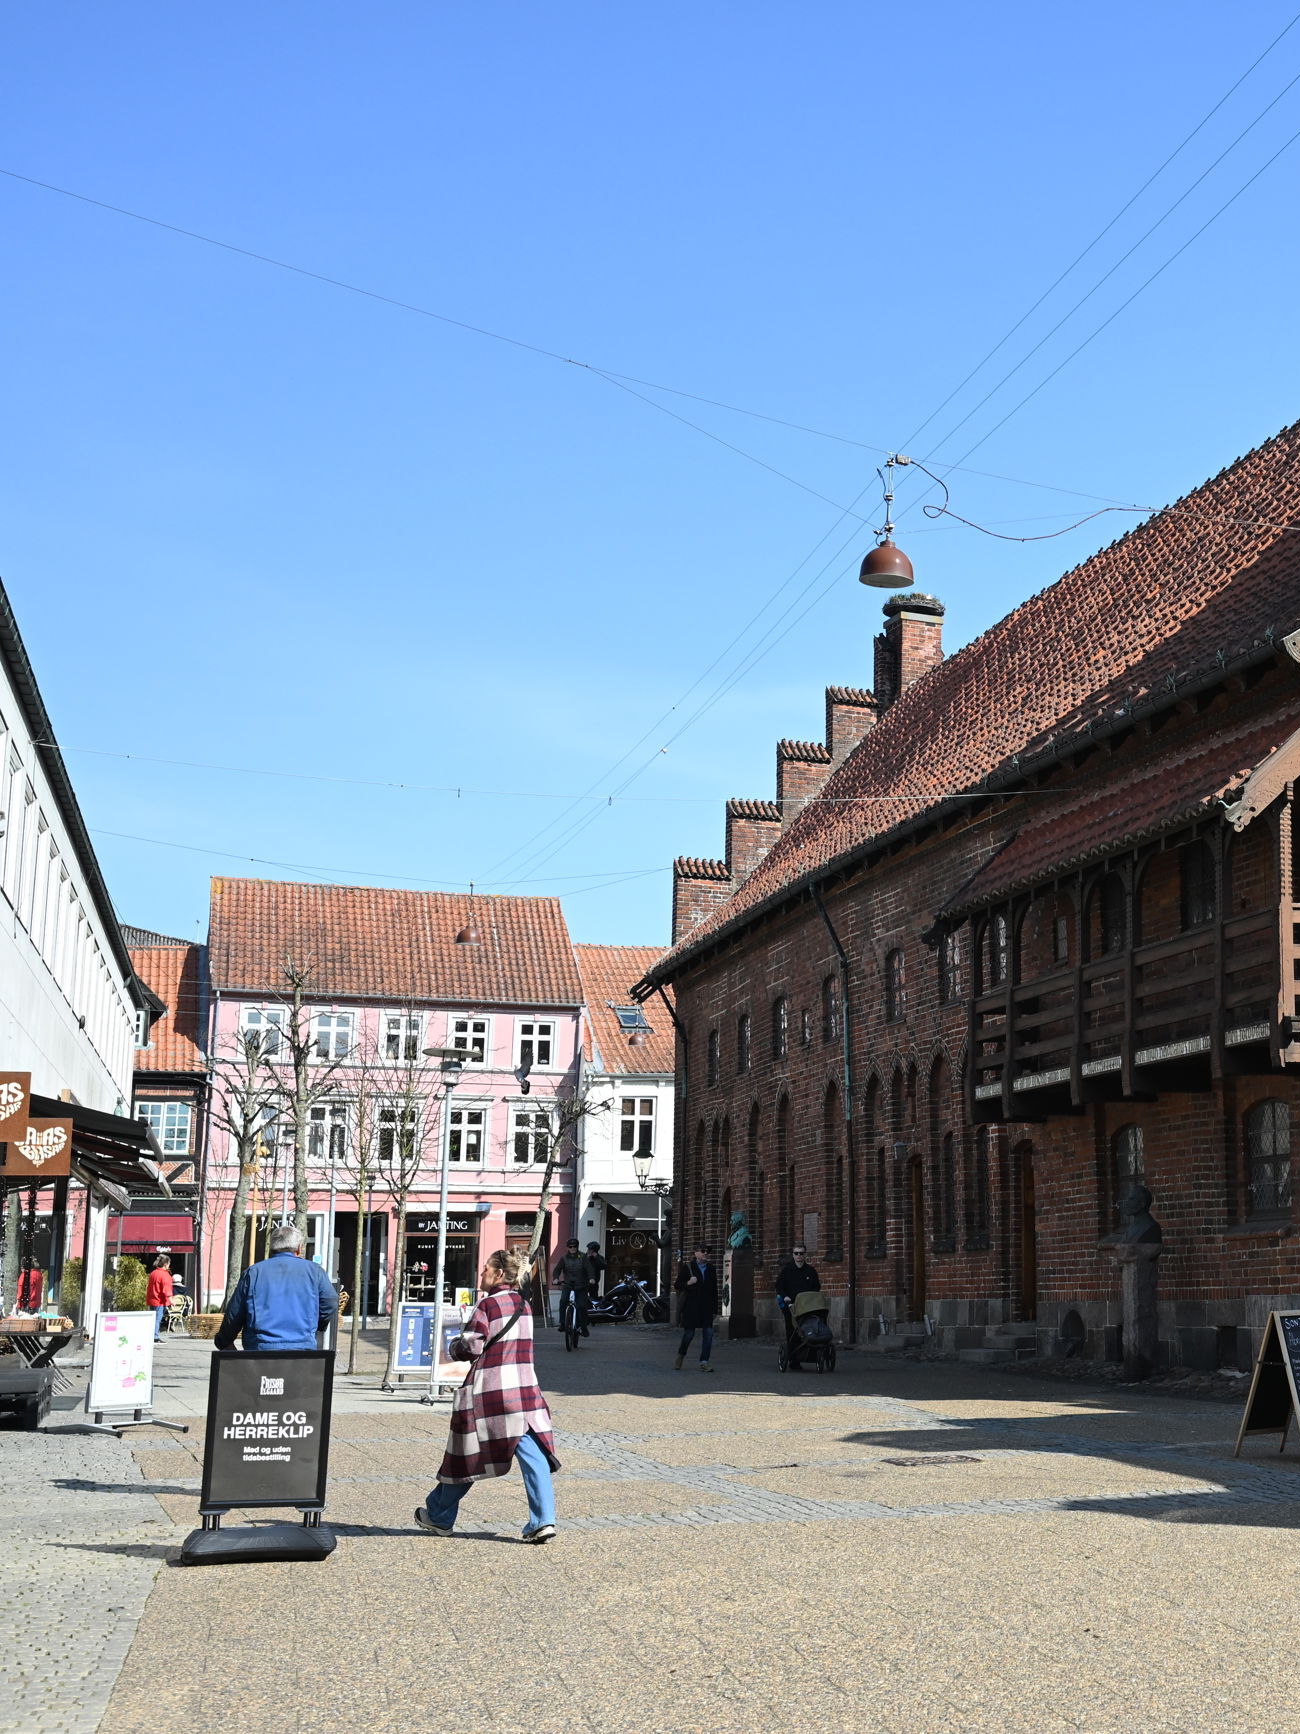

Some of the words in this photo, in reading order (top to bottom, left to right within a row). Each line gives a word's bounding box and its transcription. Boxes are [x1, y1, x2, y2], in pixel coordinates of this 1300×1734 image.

[425, 1220, 468, 1232] JATING
[612, 1235, 627, 1245] Liv
[232, 1412, 279, 1425] DAME
[282, 1411, 307, 1425] OG
[223, 1425, 314, 1439] HERREKLIP
[243, 1446, 260, 1454] Med
[260, 1447, 271, 1455] og
[272, 1445, 292, 1453] uden
[242, 1453, 291, 1462] tidsbestilling
